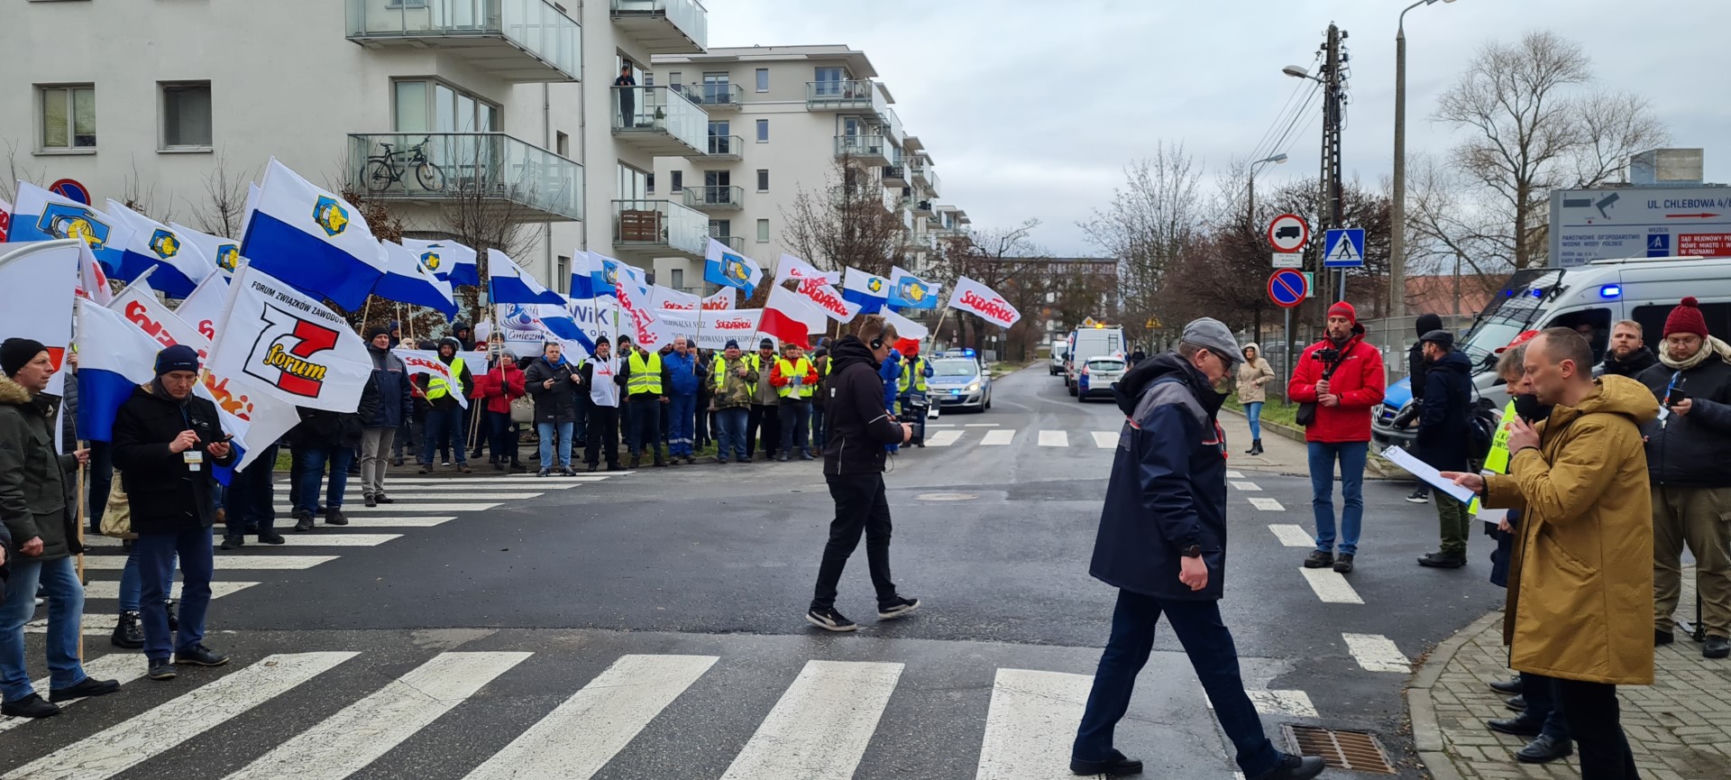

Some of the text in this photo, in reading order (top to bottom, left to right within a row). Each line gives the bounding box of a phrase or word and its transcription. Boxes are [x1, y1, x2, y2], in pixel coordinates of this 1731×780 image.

[1647, 200, 1661, 209] UL.
[1664, 199, 1716, 209] CHLEBOWA
[1654, 236, 1663, 248] A
[251, 280, 276, 298] FORUM
[275, 292, 312, 313] ZWIĄZKÓW
[263, 343, 328, 381] forum
